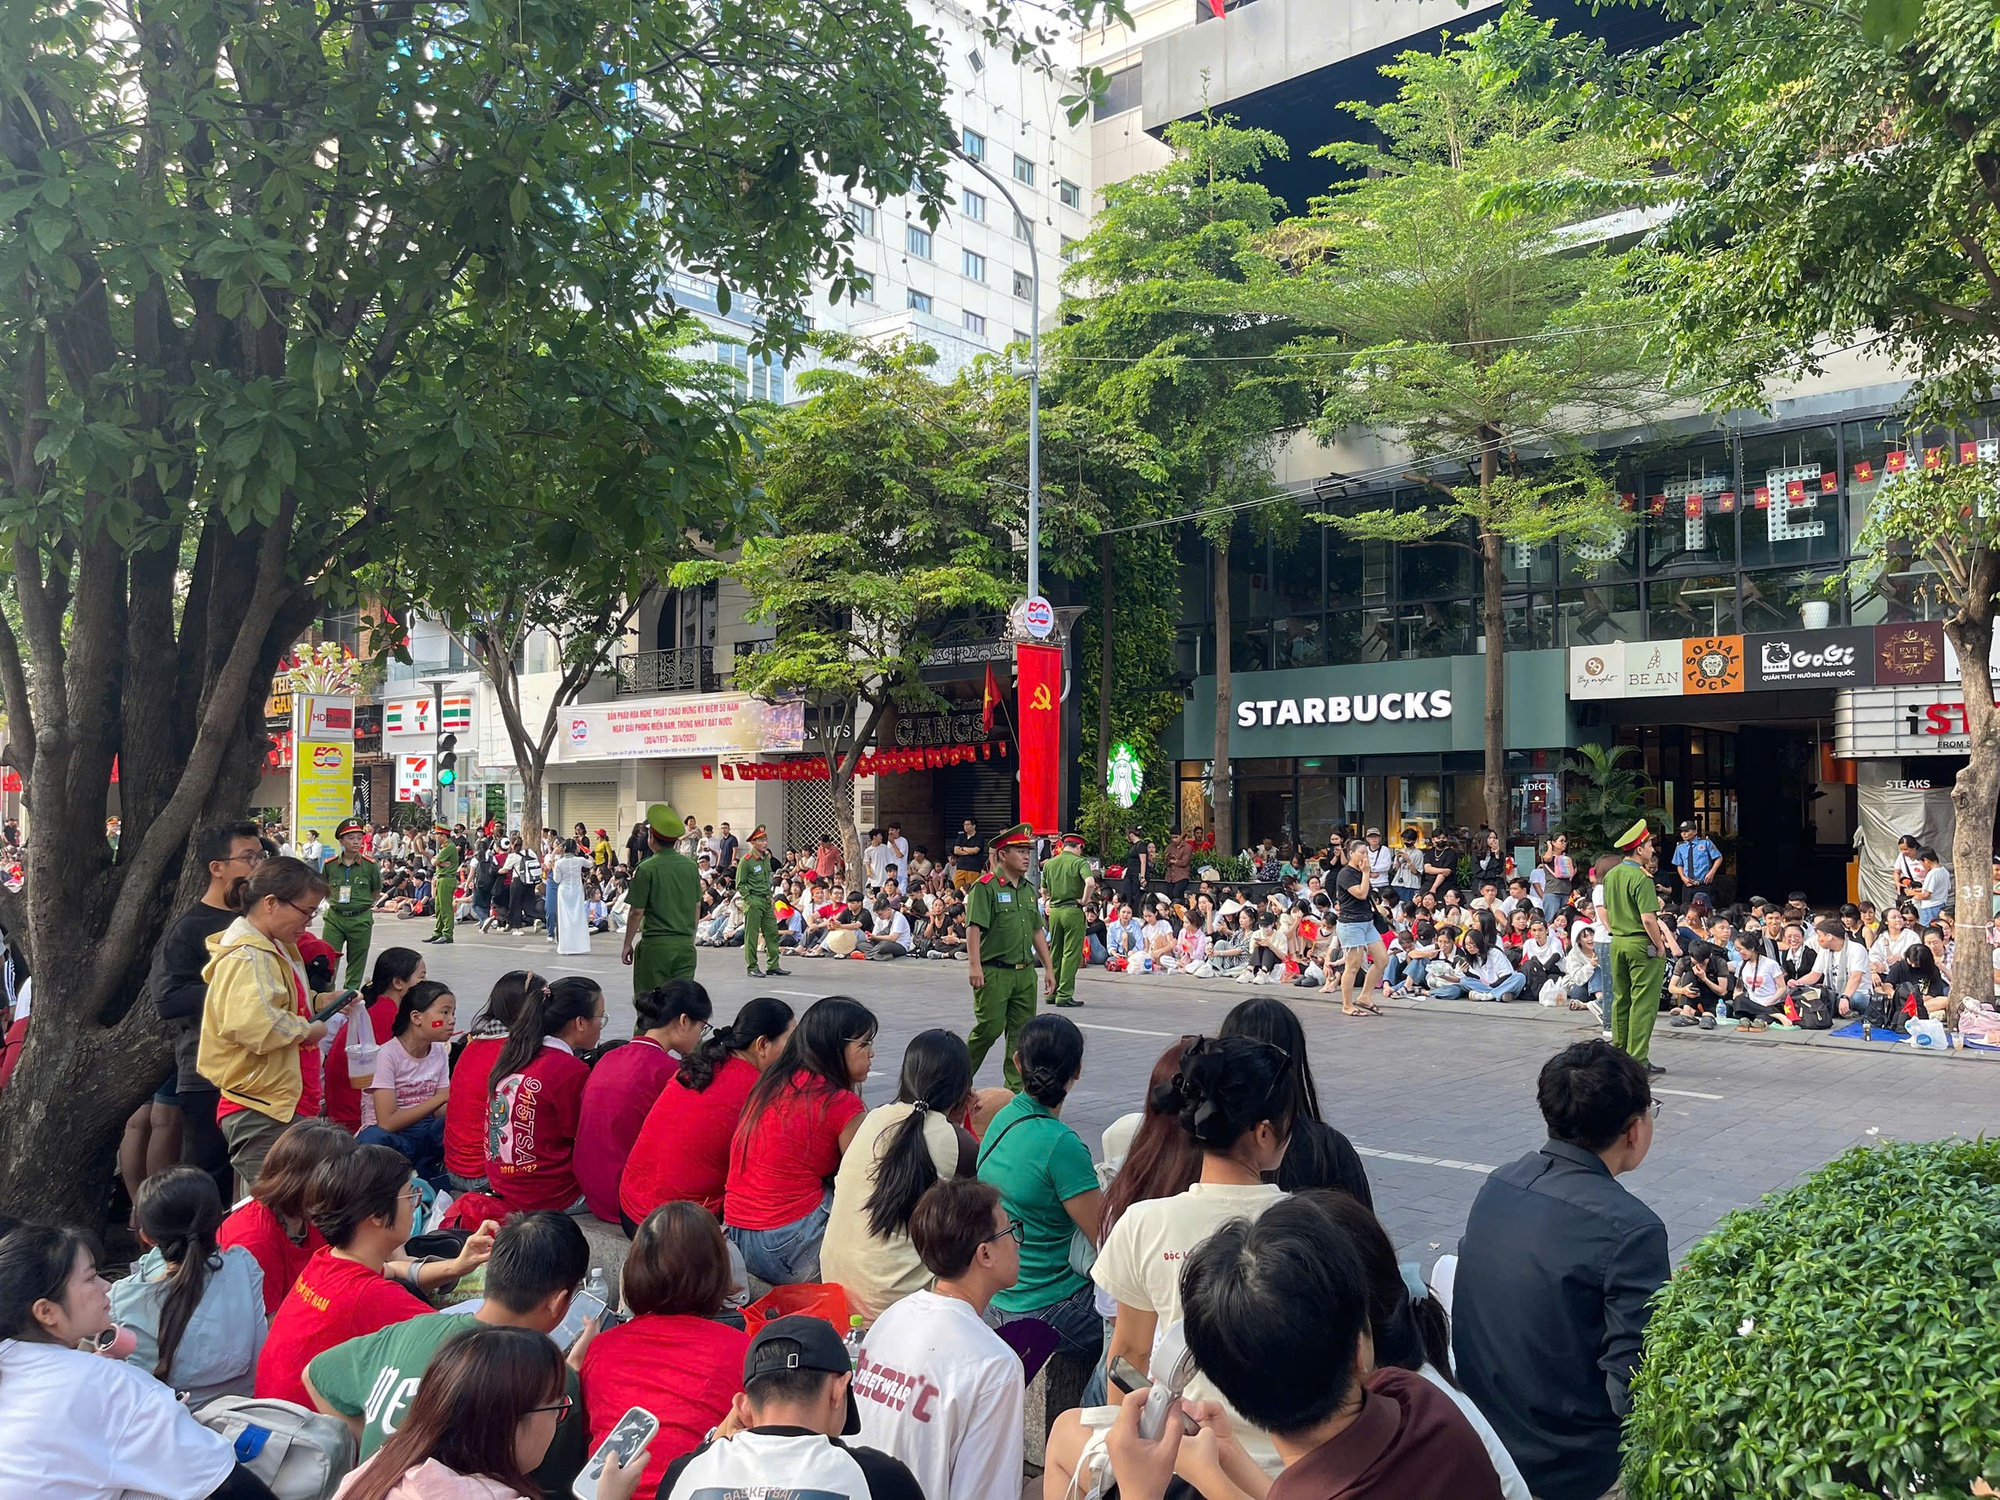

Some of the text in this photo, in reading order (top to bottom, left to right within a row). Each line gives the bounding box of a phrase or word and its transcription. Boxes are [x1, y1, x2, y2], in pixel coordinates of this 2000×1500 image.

[1686, 639, 1739, 665] SOCIAL
[1687, 671, 1739, 691] LOCAL
[1237, 689, 1453, 728] STARBUCKS
[894, 713, 989, 746] GANGS
[1886, 780, 1931, 789] STEAKS
